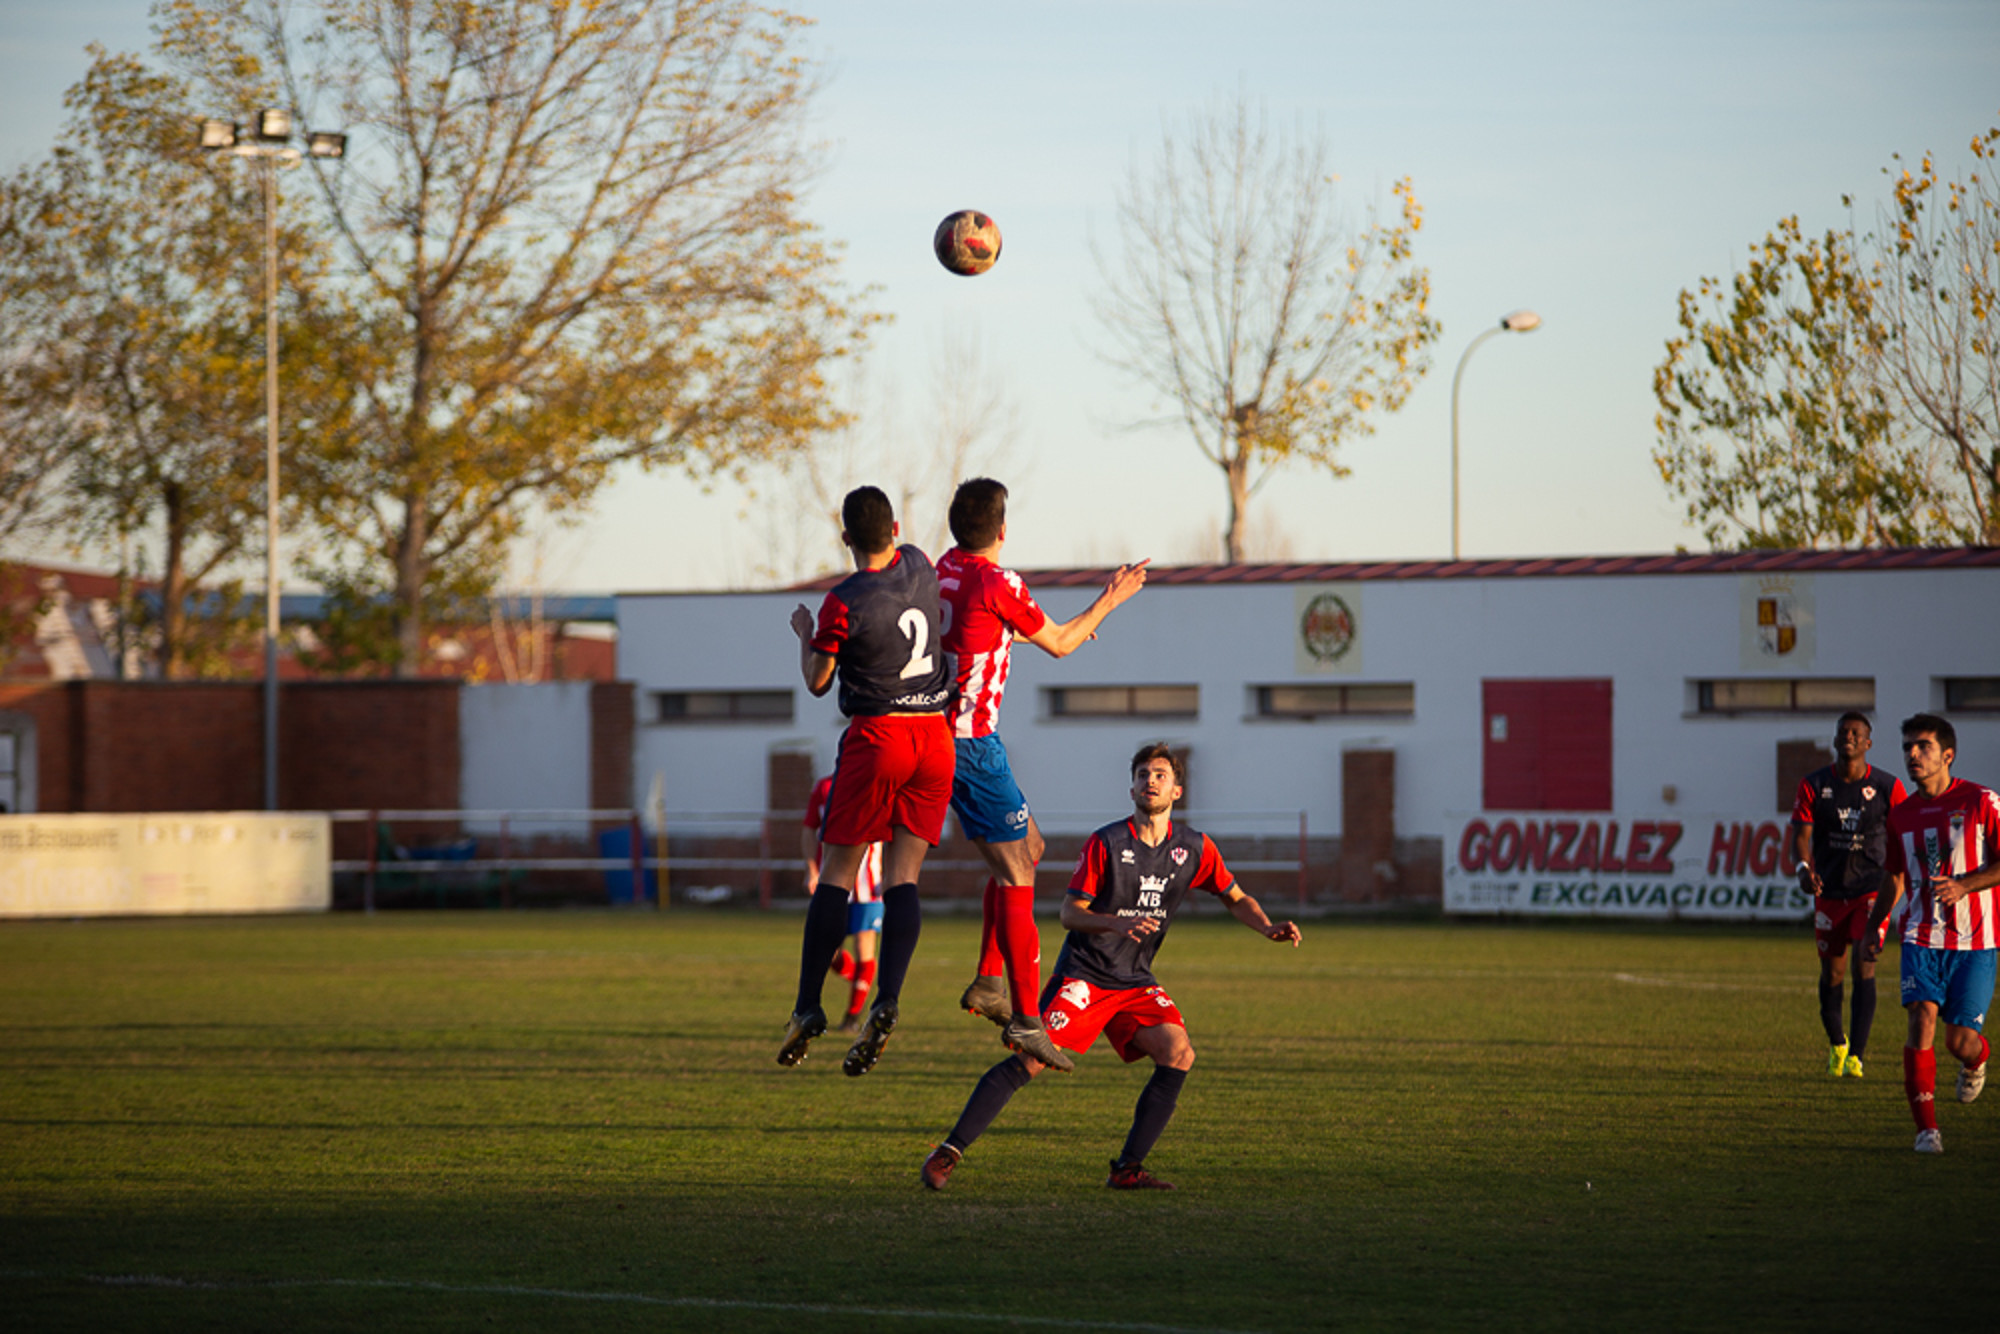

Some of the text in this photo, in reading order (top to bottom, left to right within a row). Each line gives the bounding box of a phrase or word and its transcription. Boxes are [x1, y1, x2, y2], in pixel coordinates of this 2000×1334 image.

[898, 608, 934, 680] 2
[1459, 819, 1682, 873] GONZALEZ
[1137, 891, 1161, 907] NB
[1531, 882, 1809, 908] EXCAVACIONES
